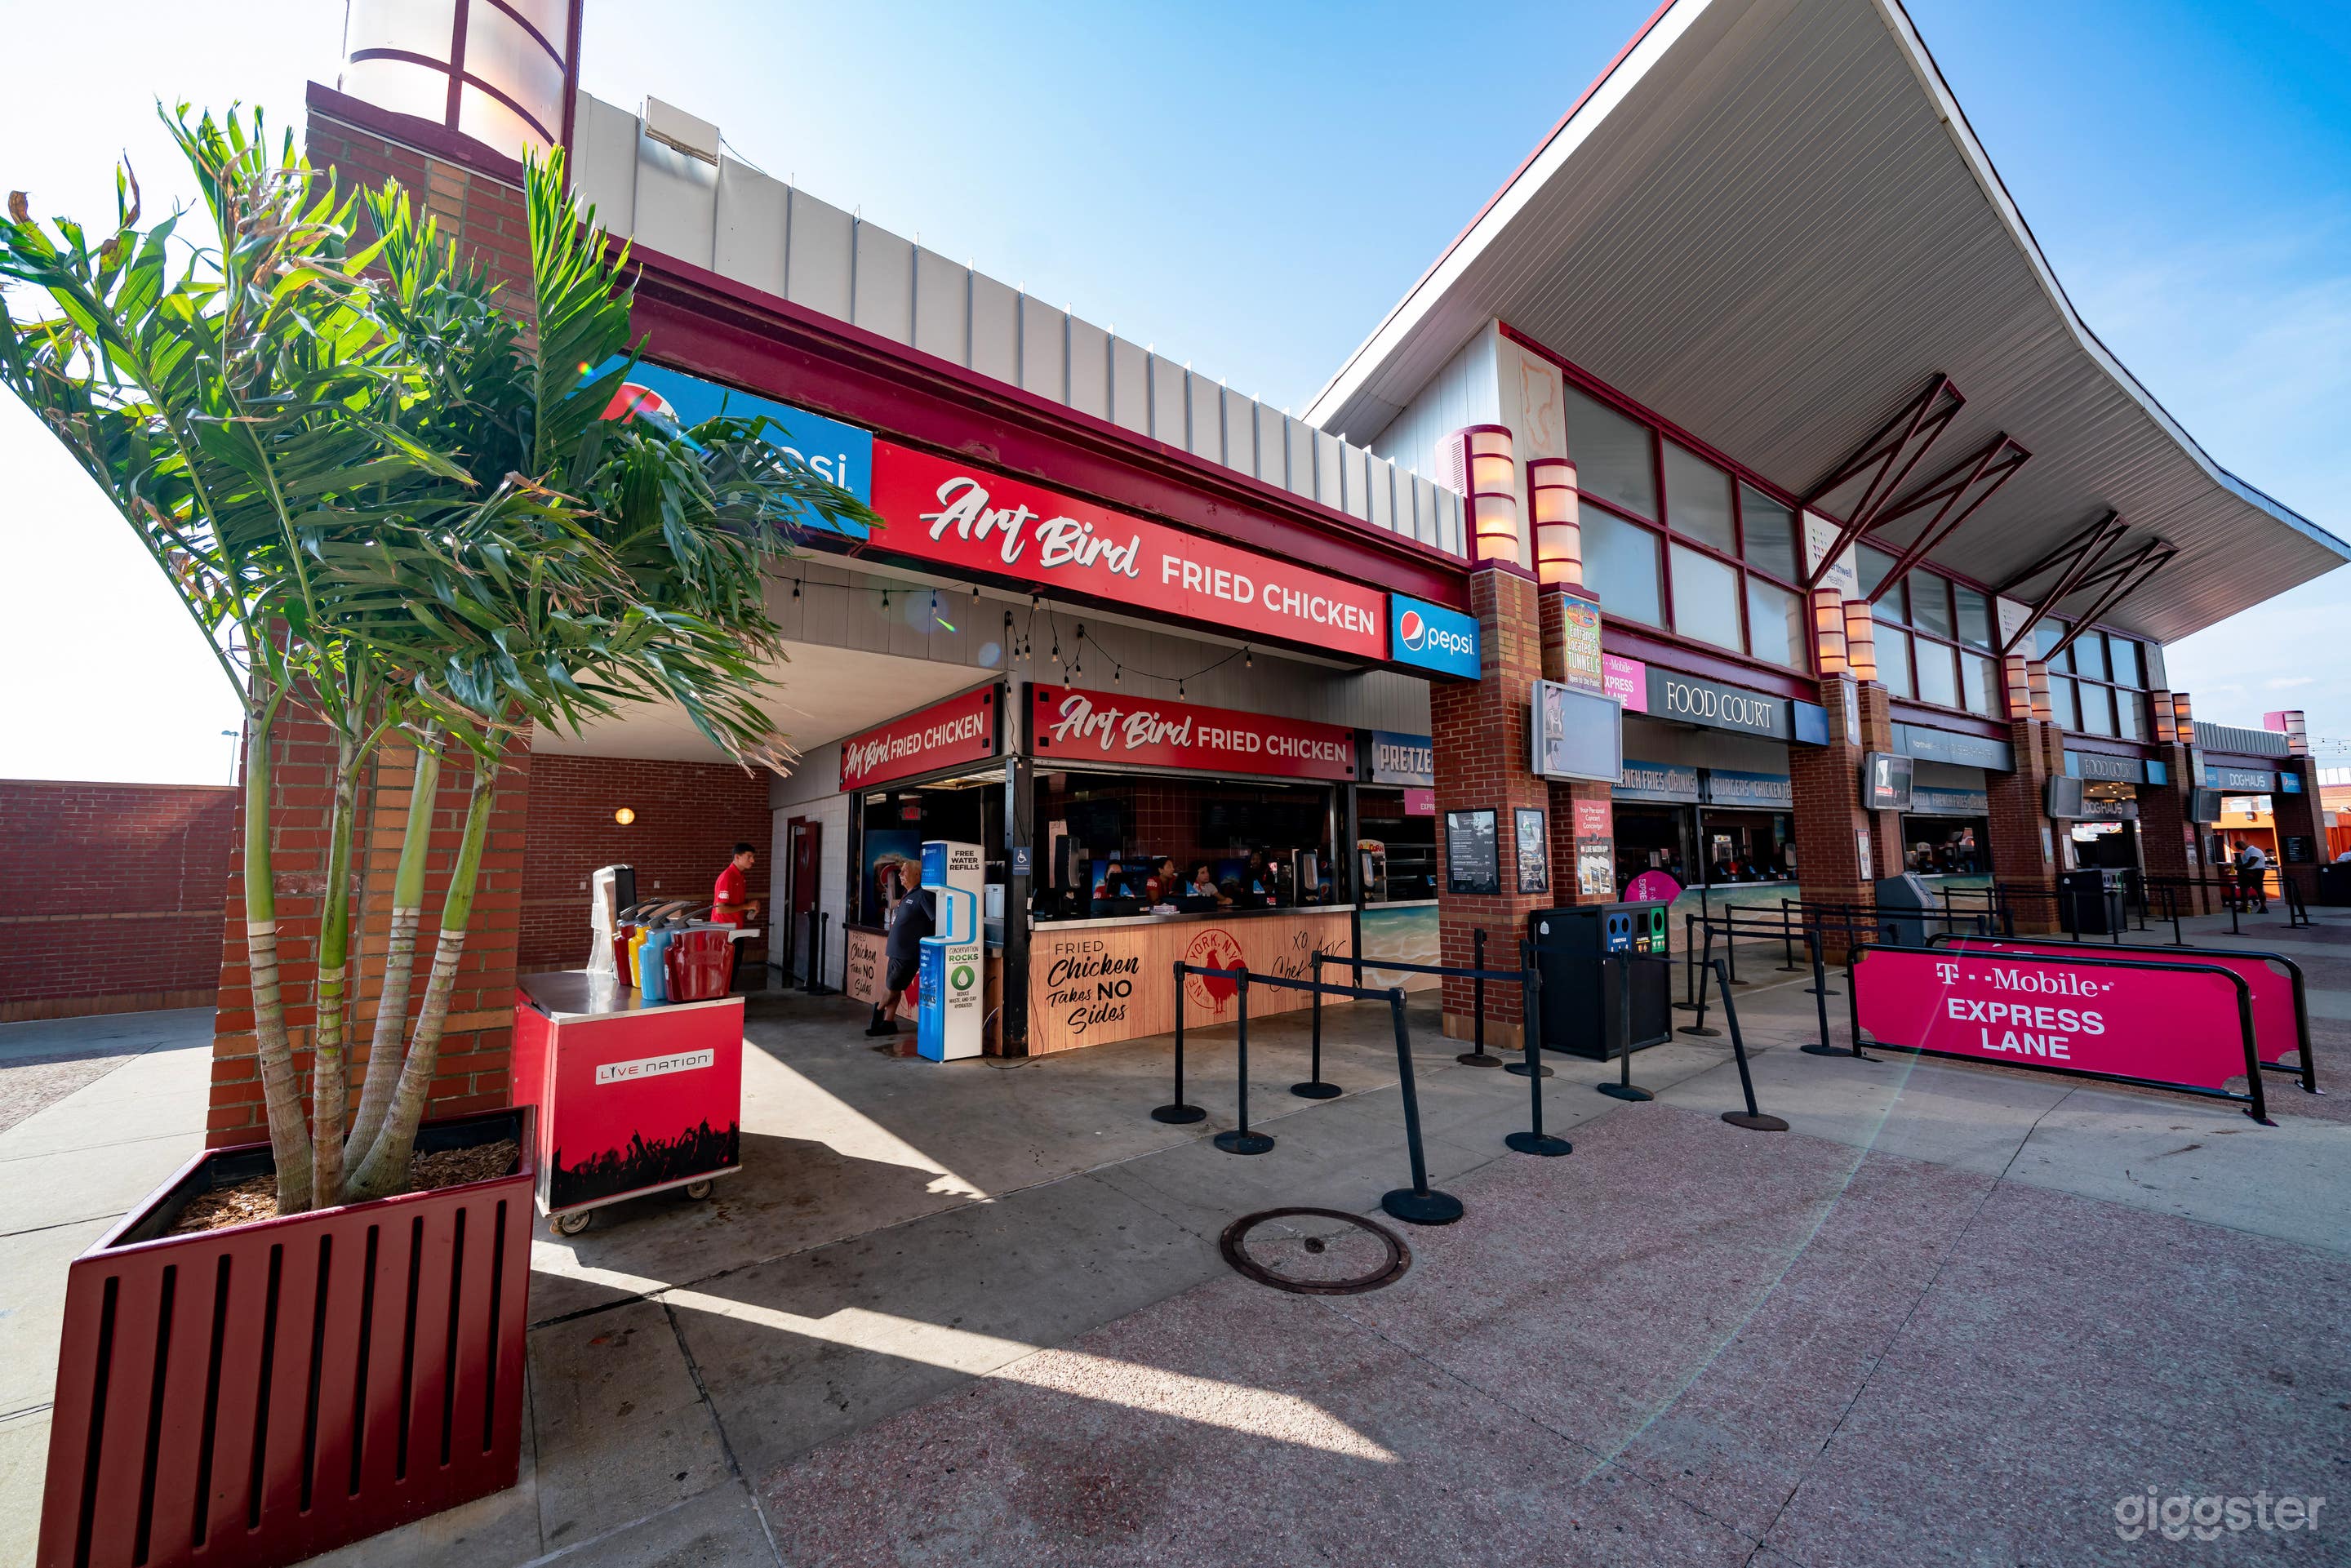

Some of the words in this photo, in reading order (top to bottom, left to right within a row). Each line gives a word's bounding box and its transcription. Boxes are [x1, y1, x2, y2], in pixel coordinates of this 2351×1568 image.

[920, 476, 1039, 565] Art
[1035, 515, 1141, 579] Bird
[1162, 554, 1255, 604] FRIED
[1263, 583, 1375, 636] CHICKEN
[1428, 627, 1473, 656] pepsi
[1570, 624, 1596, 642] Entrance
[1567, 637, 1591, 654] Located
[1592, 644, 1598, 656] at
[1567, 651, 1594, 673] TUNNEL
[1604, 675, 1633, 693] XPRESS
[1666, 681, 1717, 717] FOOD
[1721, 694, 1771, 728] COURT
[1049, 695, 1125, 751] Art
[1121, 711, 1192, 751] Bird
[1198, 726, 1260, 753] FRIED
[1267, 735, 1347, 763] CHICKEN
[845, 742, 866, 780] Art
[864, 733, 891, 775] Bird
[891, 733, 921, 760] FRIED
[924, 711, 984, 750] CHICKEN
[1380, 744, 1433, 773] PRETZE
[2085, 758, 2107, 776] FOOD
[1642, 770, 1664, 791] FRIES
[1668, 772, 1695, 793] DRINKS
[1714, 777, 1749, 797] BURGERS
[1754, 780, 1782, 798] CHICKEN
[2229, 773, 2243, 786] DOG
[2084, 802, 2101, 814] DOG
[2101, 802, 2122, 815] HAUS
[1055, 940, 1104, 954] FRIED
[1292, 931, 1309, 951] XO
[851, 942, 876, 963] Chicken
[949, 953, 979, 962] ROCKS
[864, 964, 874, 979] NO
[1047, 953, 1140, 988] Chicken
[1047, 989, 1094, 1008] Takes
[1097, 979, 1132, 1001] NO
[1067, 1002, 1128, 1035] Sides
[1947, 997, 2105, 1035] EXPRESS
[1981, 1028, 2071, 1059] LANE
[601, 1064, 639, 1080] LIVE
[646, 1055, 708, 1073] NATION
